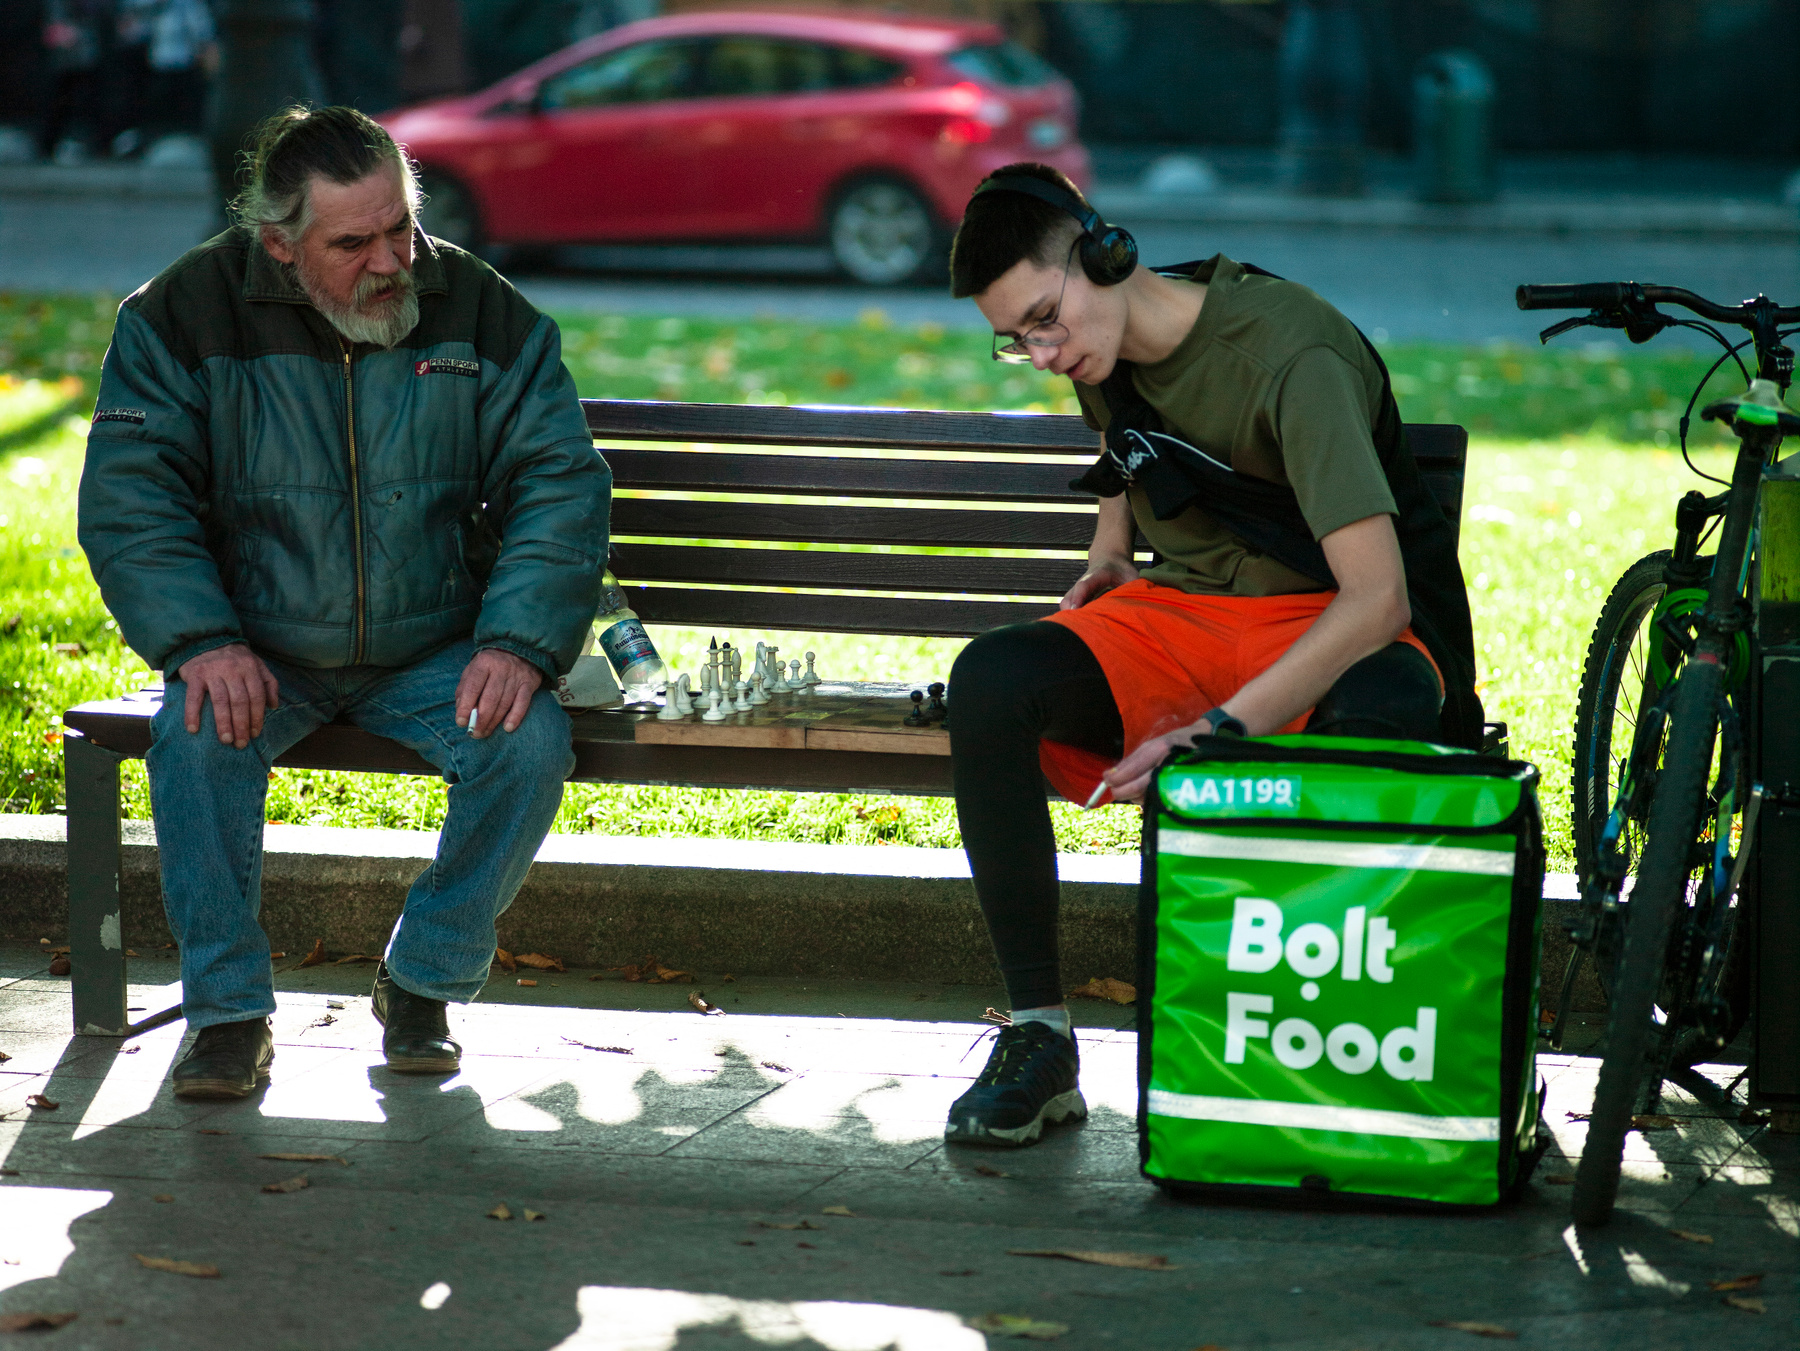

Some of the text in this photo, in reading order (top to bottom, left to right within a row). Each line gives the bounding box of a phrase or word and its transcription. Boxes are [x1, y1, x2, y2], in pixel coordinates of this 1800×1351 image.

[1178, 778, 1292, 804] AA1199
[1227, 896, 1397, 984] Bolt
[1224, 992, 1438, 1082] Food
